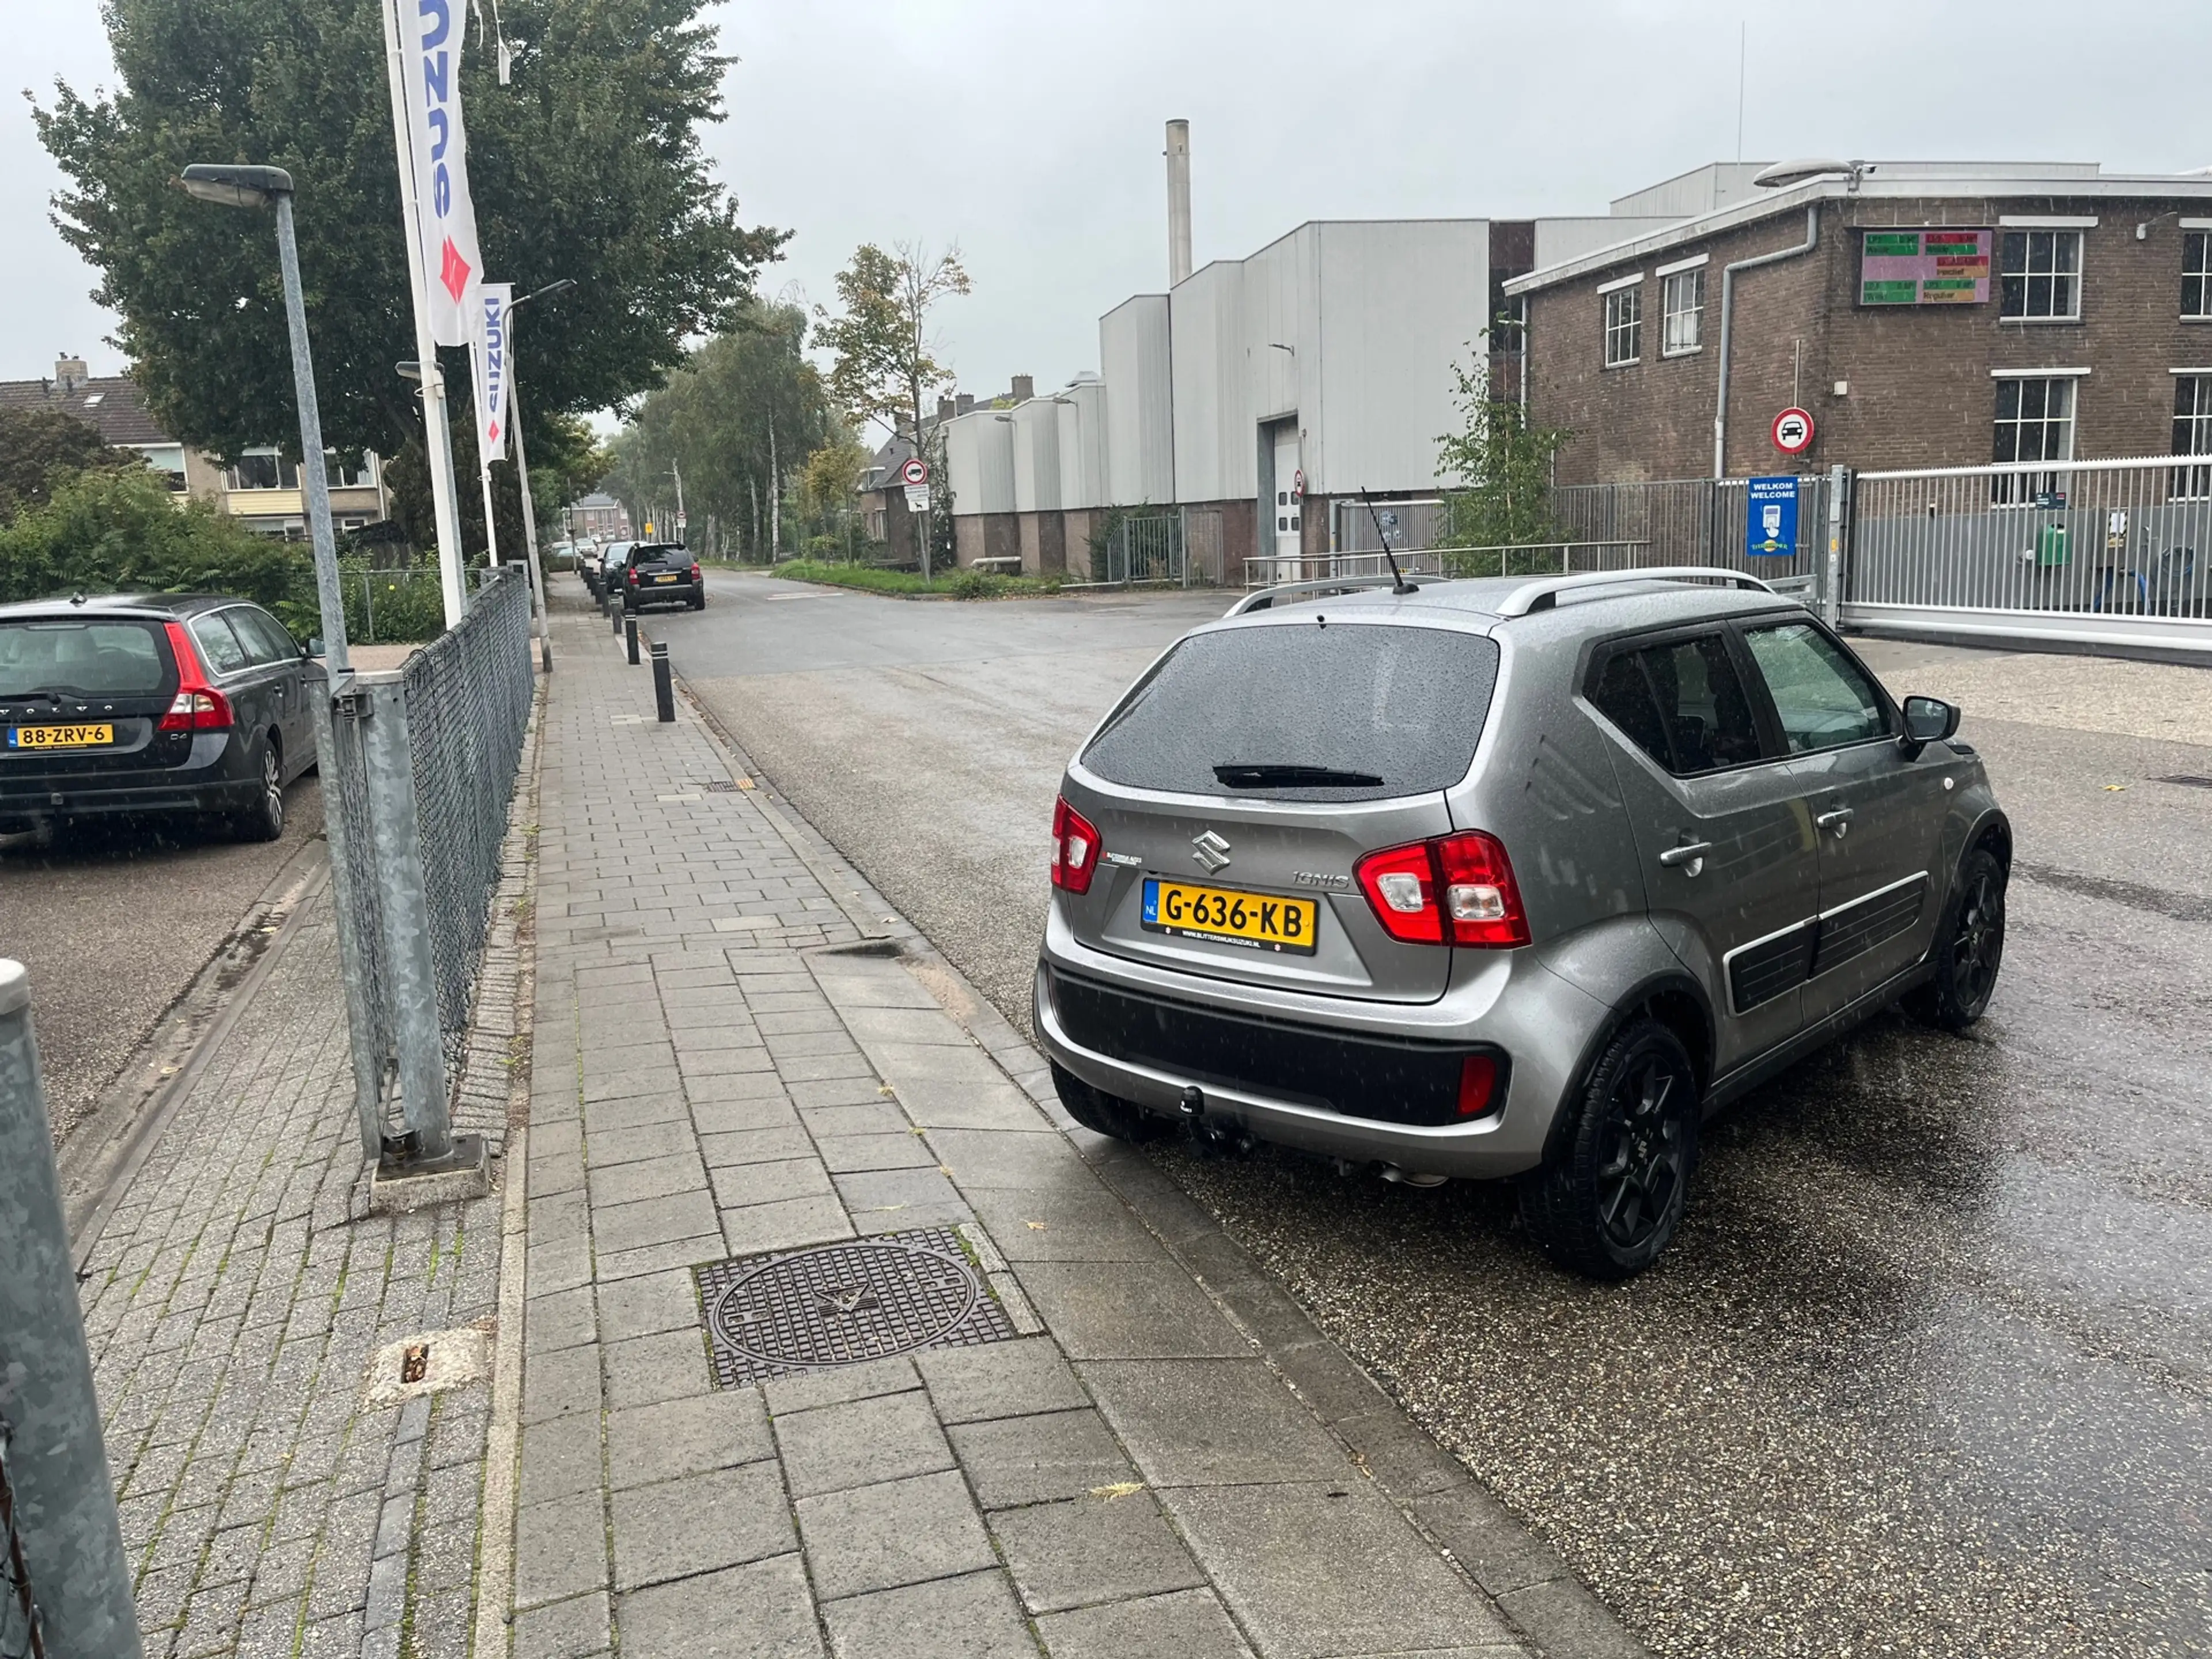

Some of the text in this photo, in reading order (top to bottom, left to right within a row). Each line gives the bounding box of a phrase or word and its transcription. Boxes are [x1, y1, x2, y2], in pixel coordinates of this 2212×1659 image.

[484, 297, 502, 413] SUZUKI
[1750, 491, 1796, 499] WELCOME
[1753, 482, 1794, 491] WELKOM
[22, 727, 105, 744] 88-ZRV-6
[1293, 870, 1350, 889] IGNIS
[1145, 904, 1157, 916] NL
[1165, 889, 1302, 937] G-636-KB
